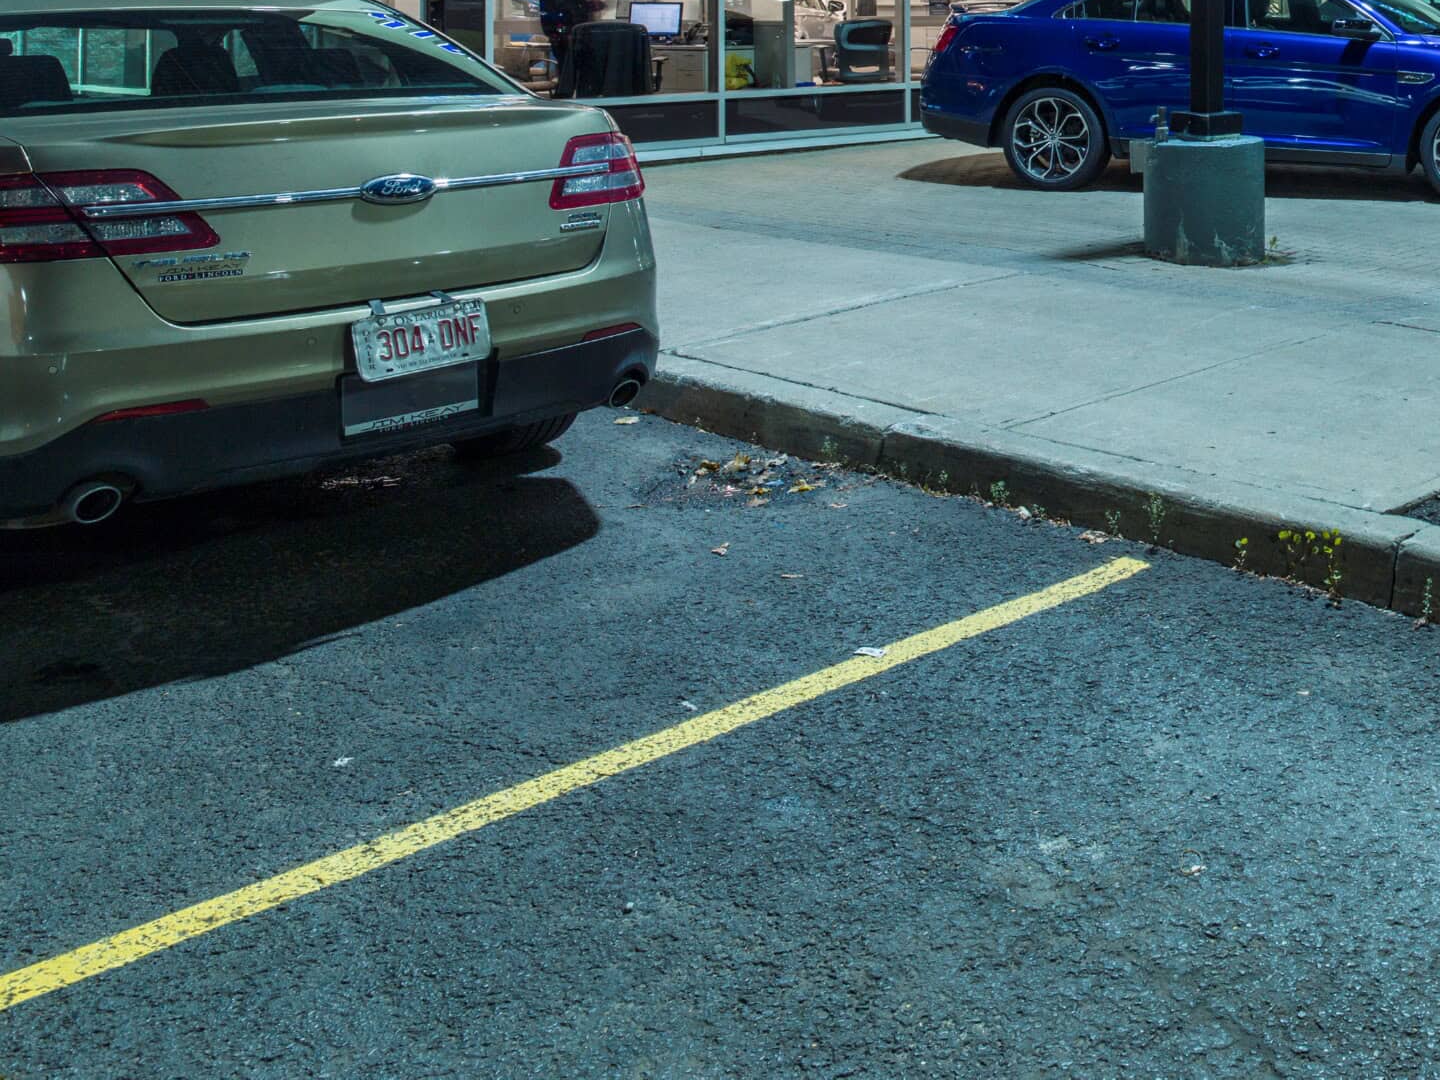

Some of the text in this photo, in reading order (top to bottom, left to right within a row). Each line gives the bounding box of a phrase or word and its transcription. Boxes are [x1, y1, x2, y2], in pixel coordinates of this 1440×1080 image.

[382, 178, 423, 195] Ford
[376, 313, 481, 361] 304 DNF
[410, 403, 466, 420] KEAY
